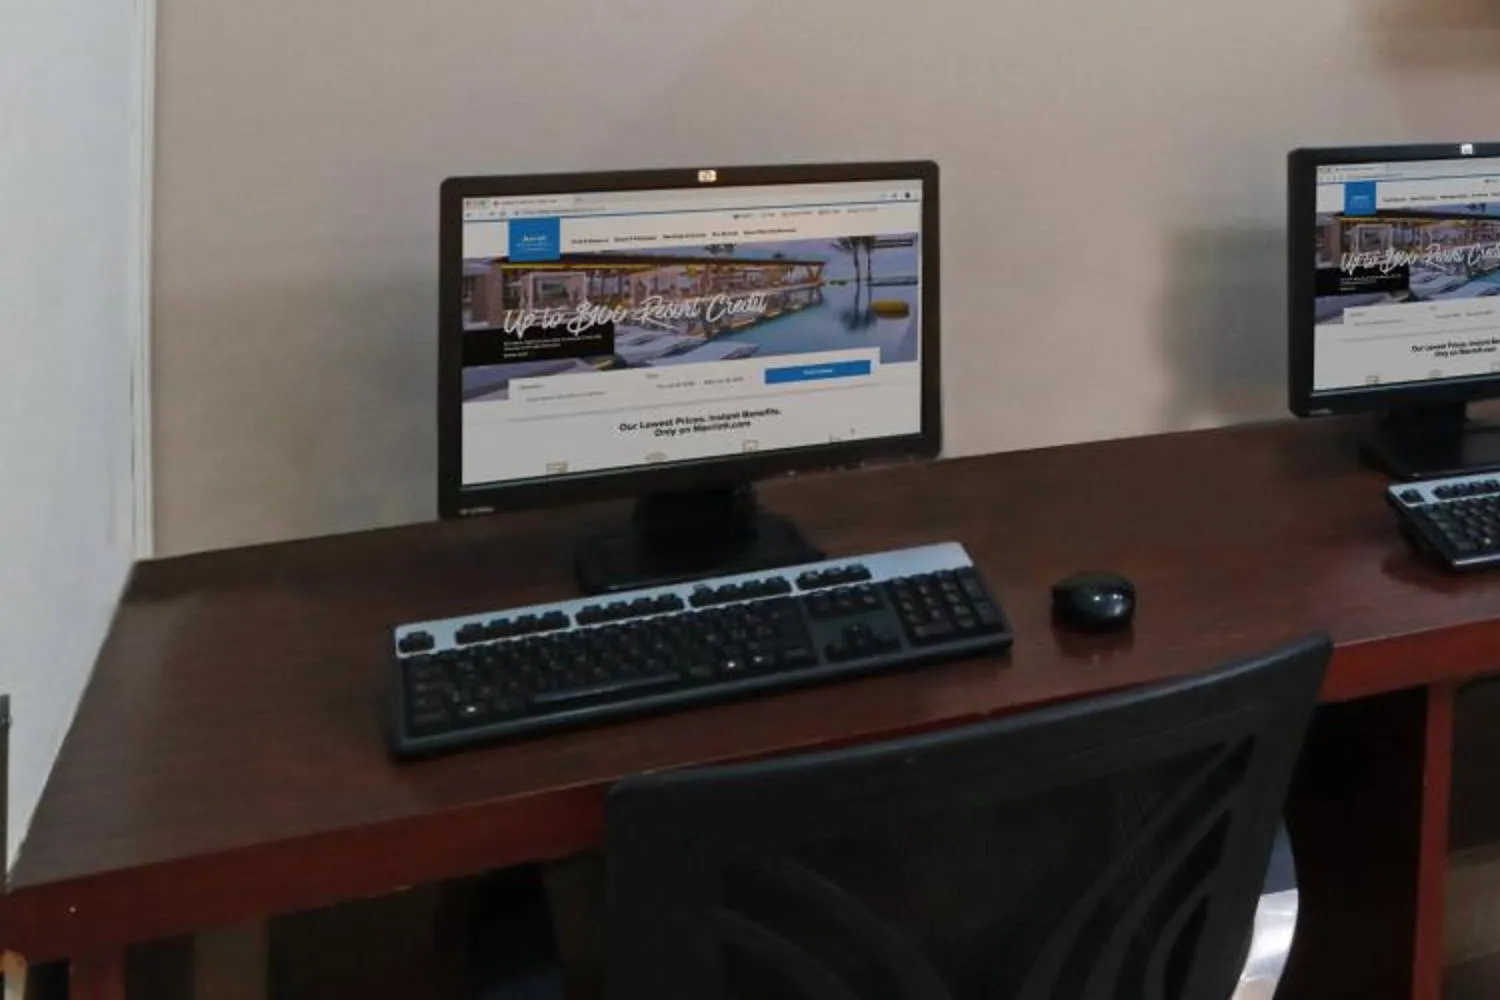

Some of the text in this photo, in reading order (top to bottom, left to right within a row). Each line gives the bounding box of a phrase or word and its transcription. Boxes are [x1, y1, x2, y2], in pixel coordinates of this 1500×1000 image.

[504, 309, 536, 339] Up
[540, 309, 561, 330] to
[633, 295, 699, 330] Resort
[705, 294, 768, 322] Credit
